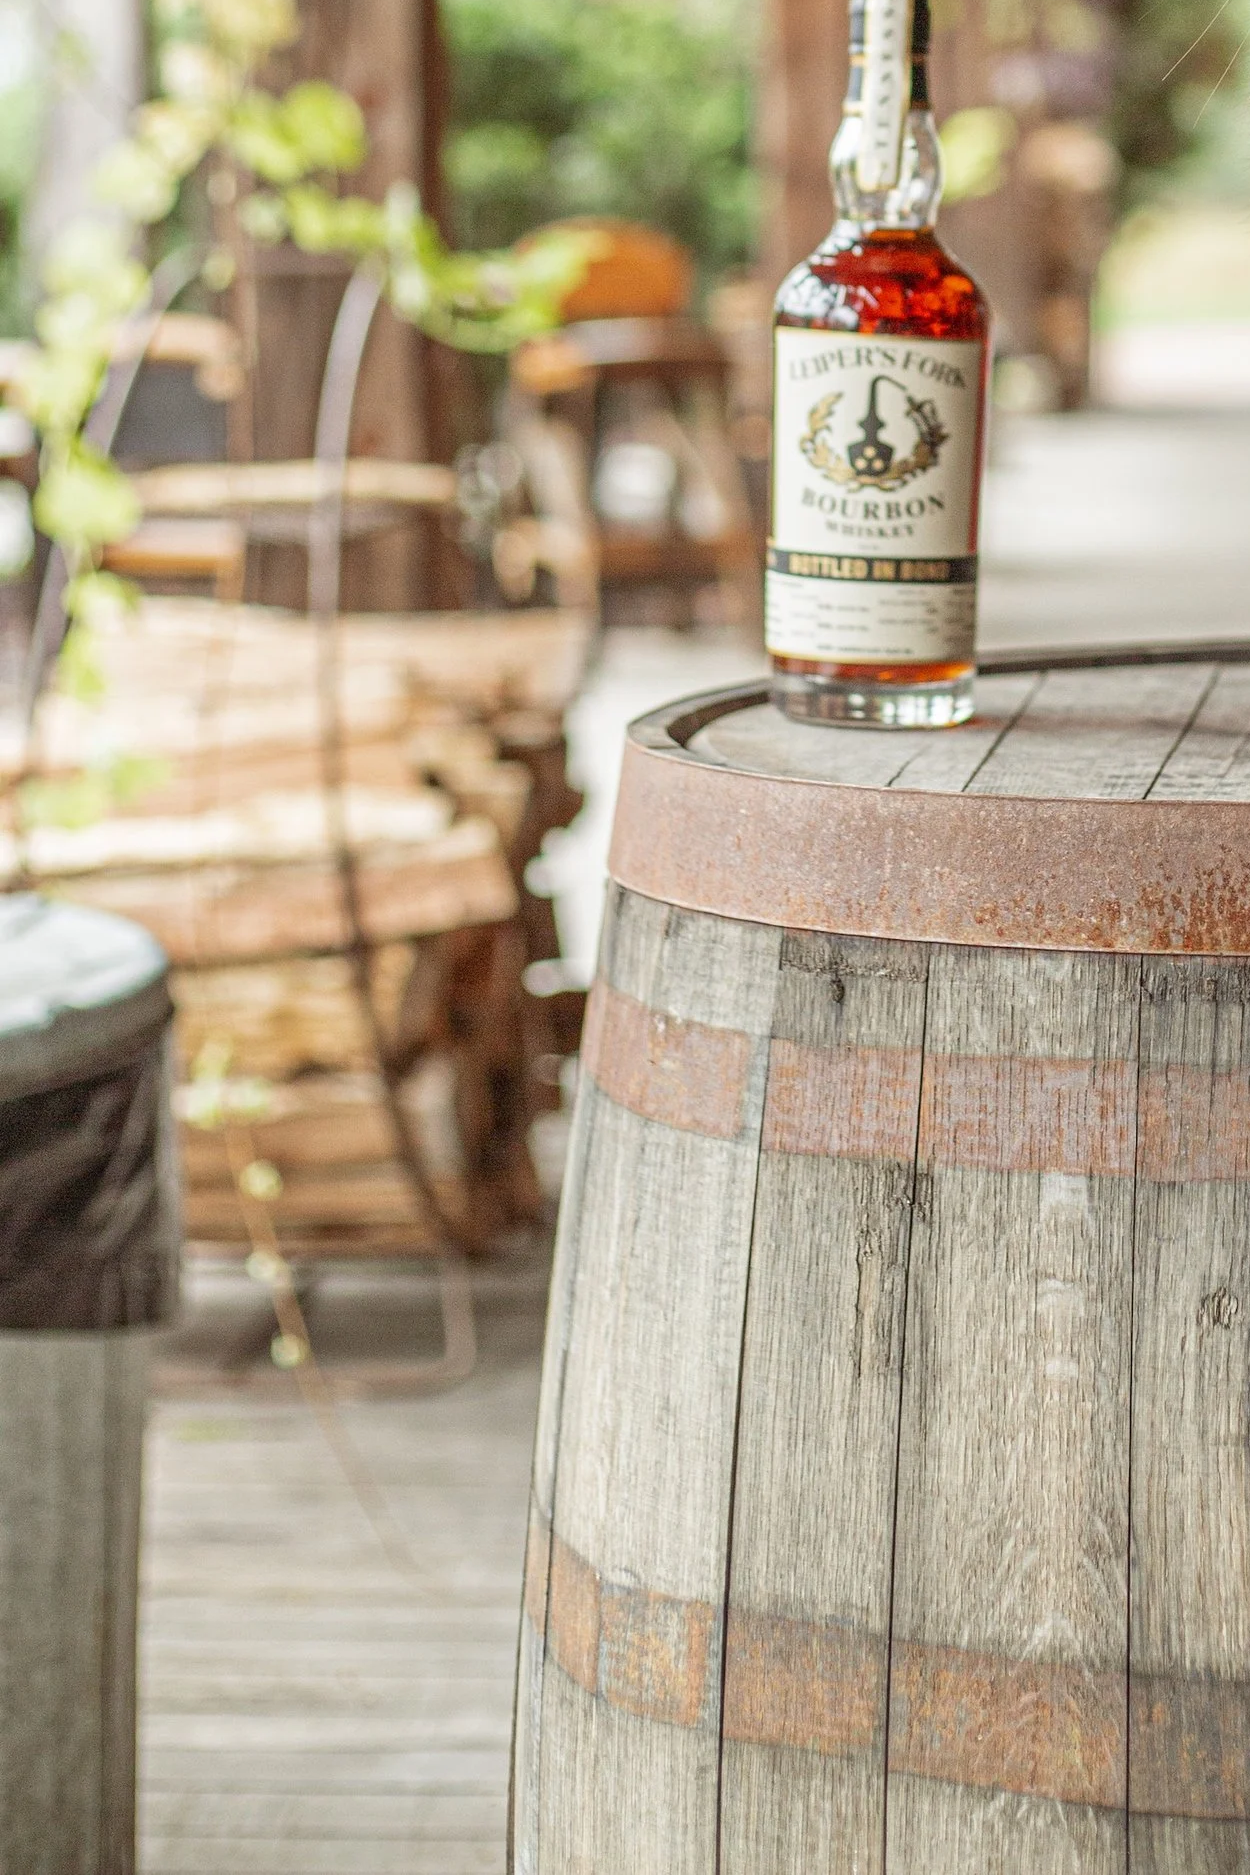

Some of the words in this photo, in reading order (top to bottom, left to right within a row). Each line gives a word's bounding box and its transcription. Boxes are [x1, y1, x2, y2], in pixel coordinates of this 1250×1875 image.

[790, 346, 897, 381] LEIPER'S
[902, 350, 967, 389] FORK
[800, 486, 946, 521] BOURBON
[826, 521, 914, 538] WHISKEY
[789, 553, 868, 579] BOTTLED
[872, 561, 896, 581] IN
